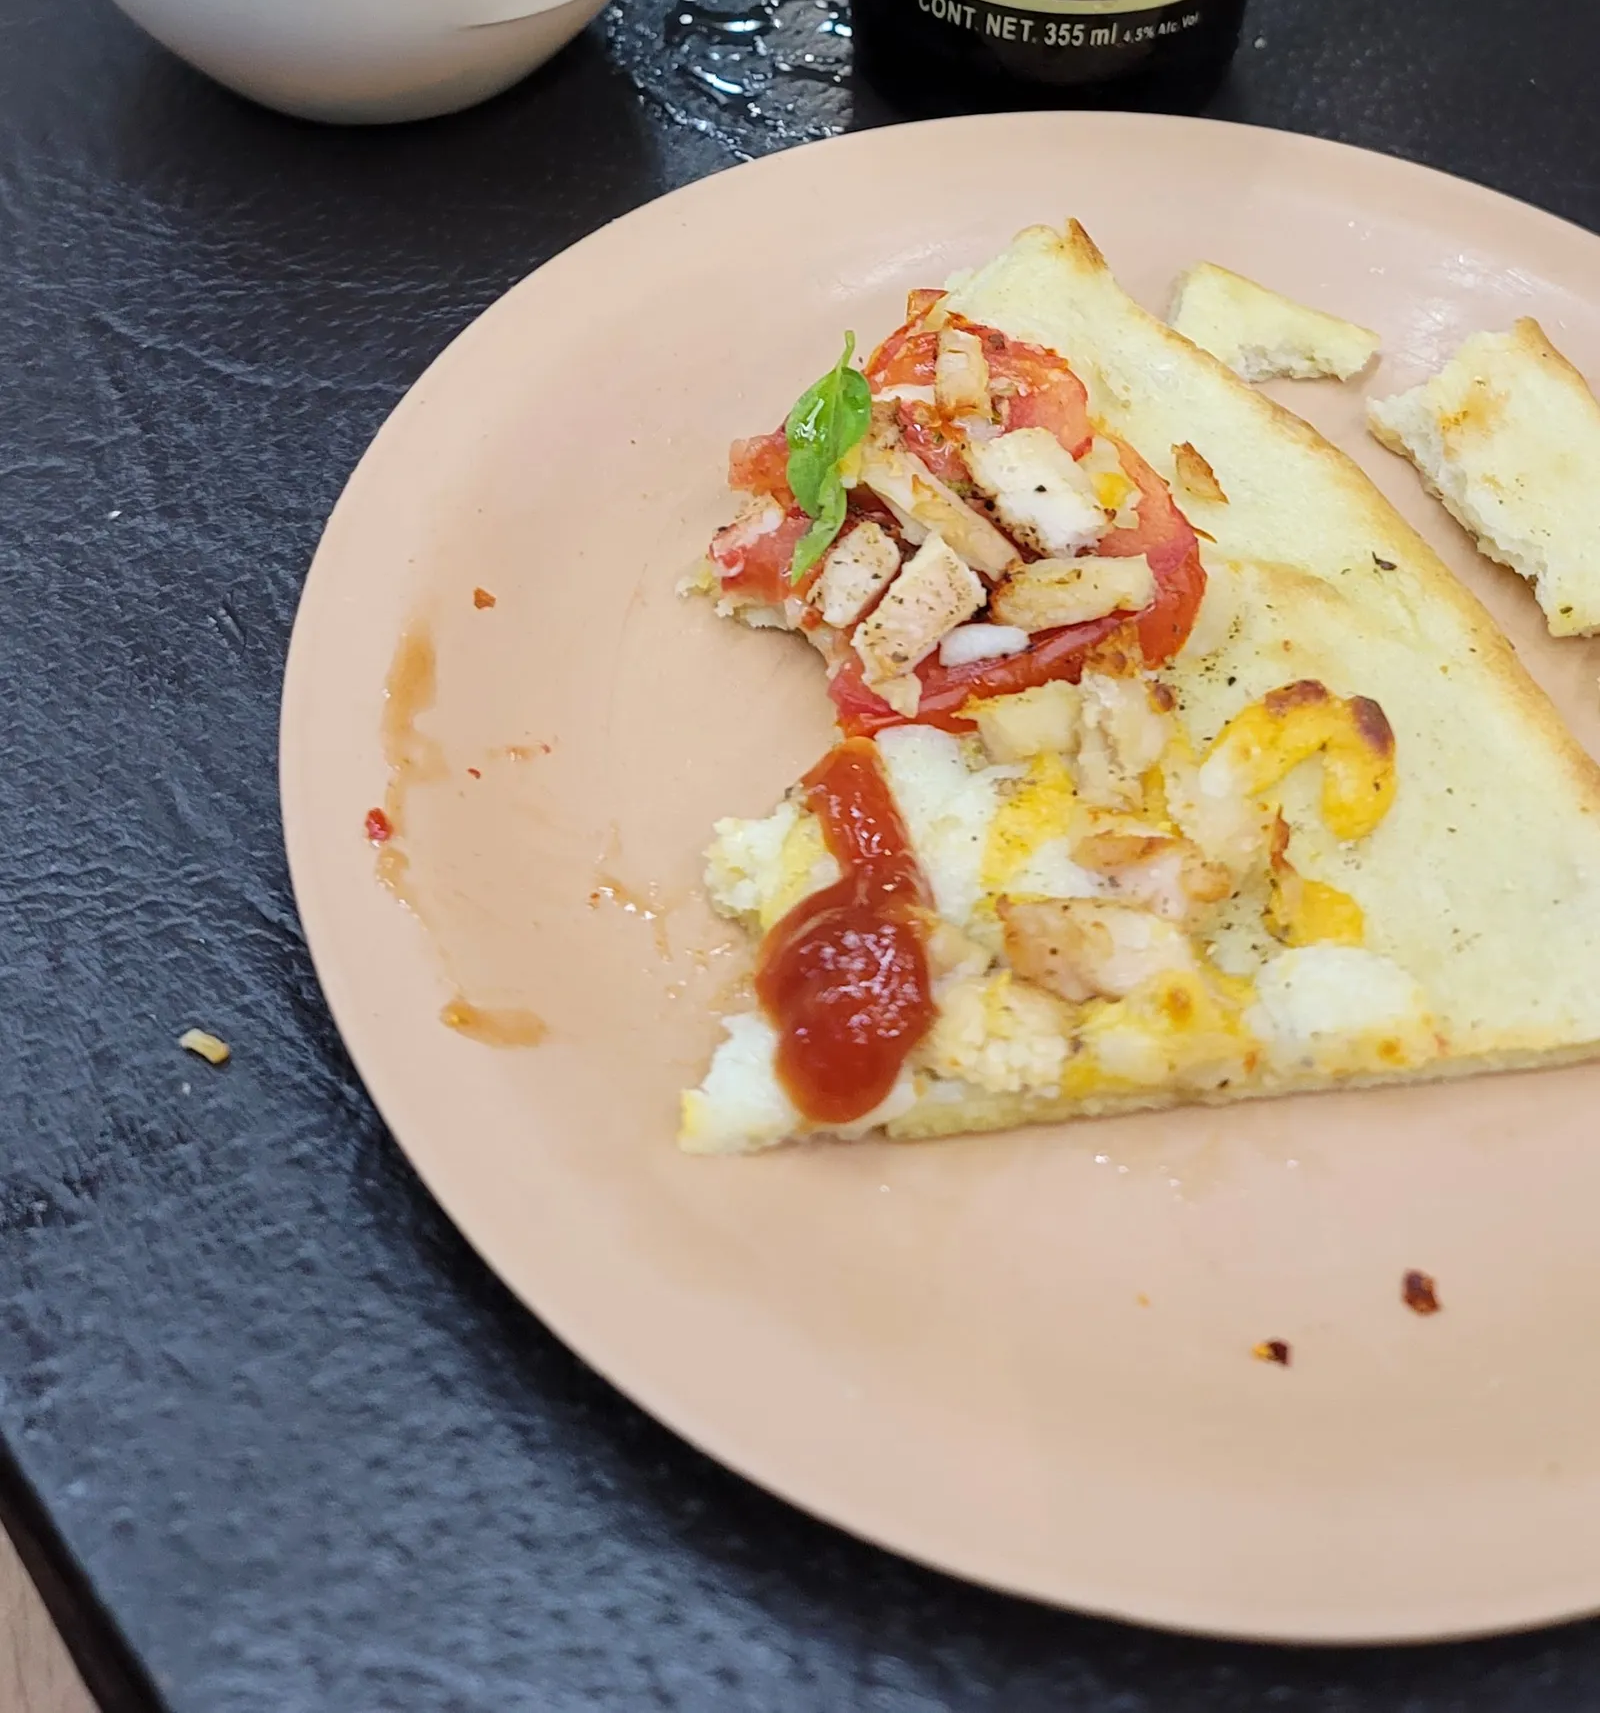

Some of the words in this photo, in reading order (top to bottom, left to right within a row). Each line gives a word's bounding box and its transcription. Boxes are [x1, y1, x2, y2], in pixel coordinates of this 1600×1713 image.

[985, 12, 1037, 44] NET.
[1043, 22, 1085, 47] 355
[1089, 22, 1118, 47] ml
